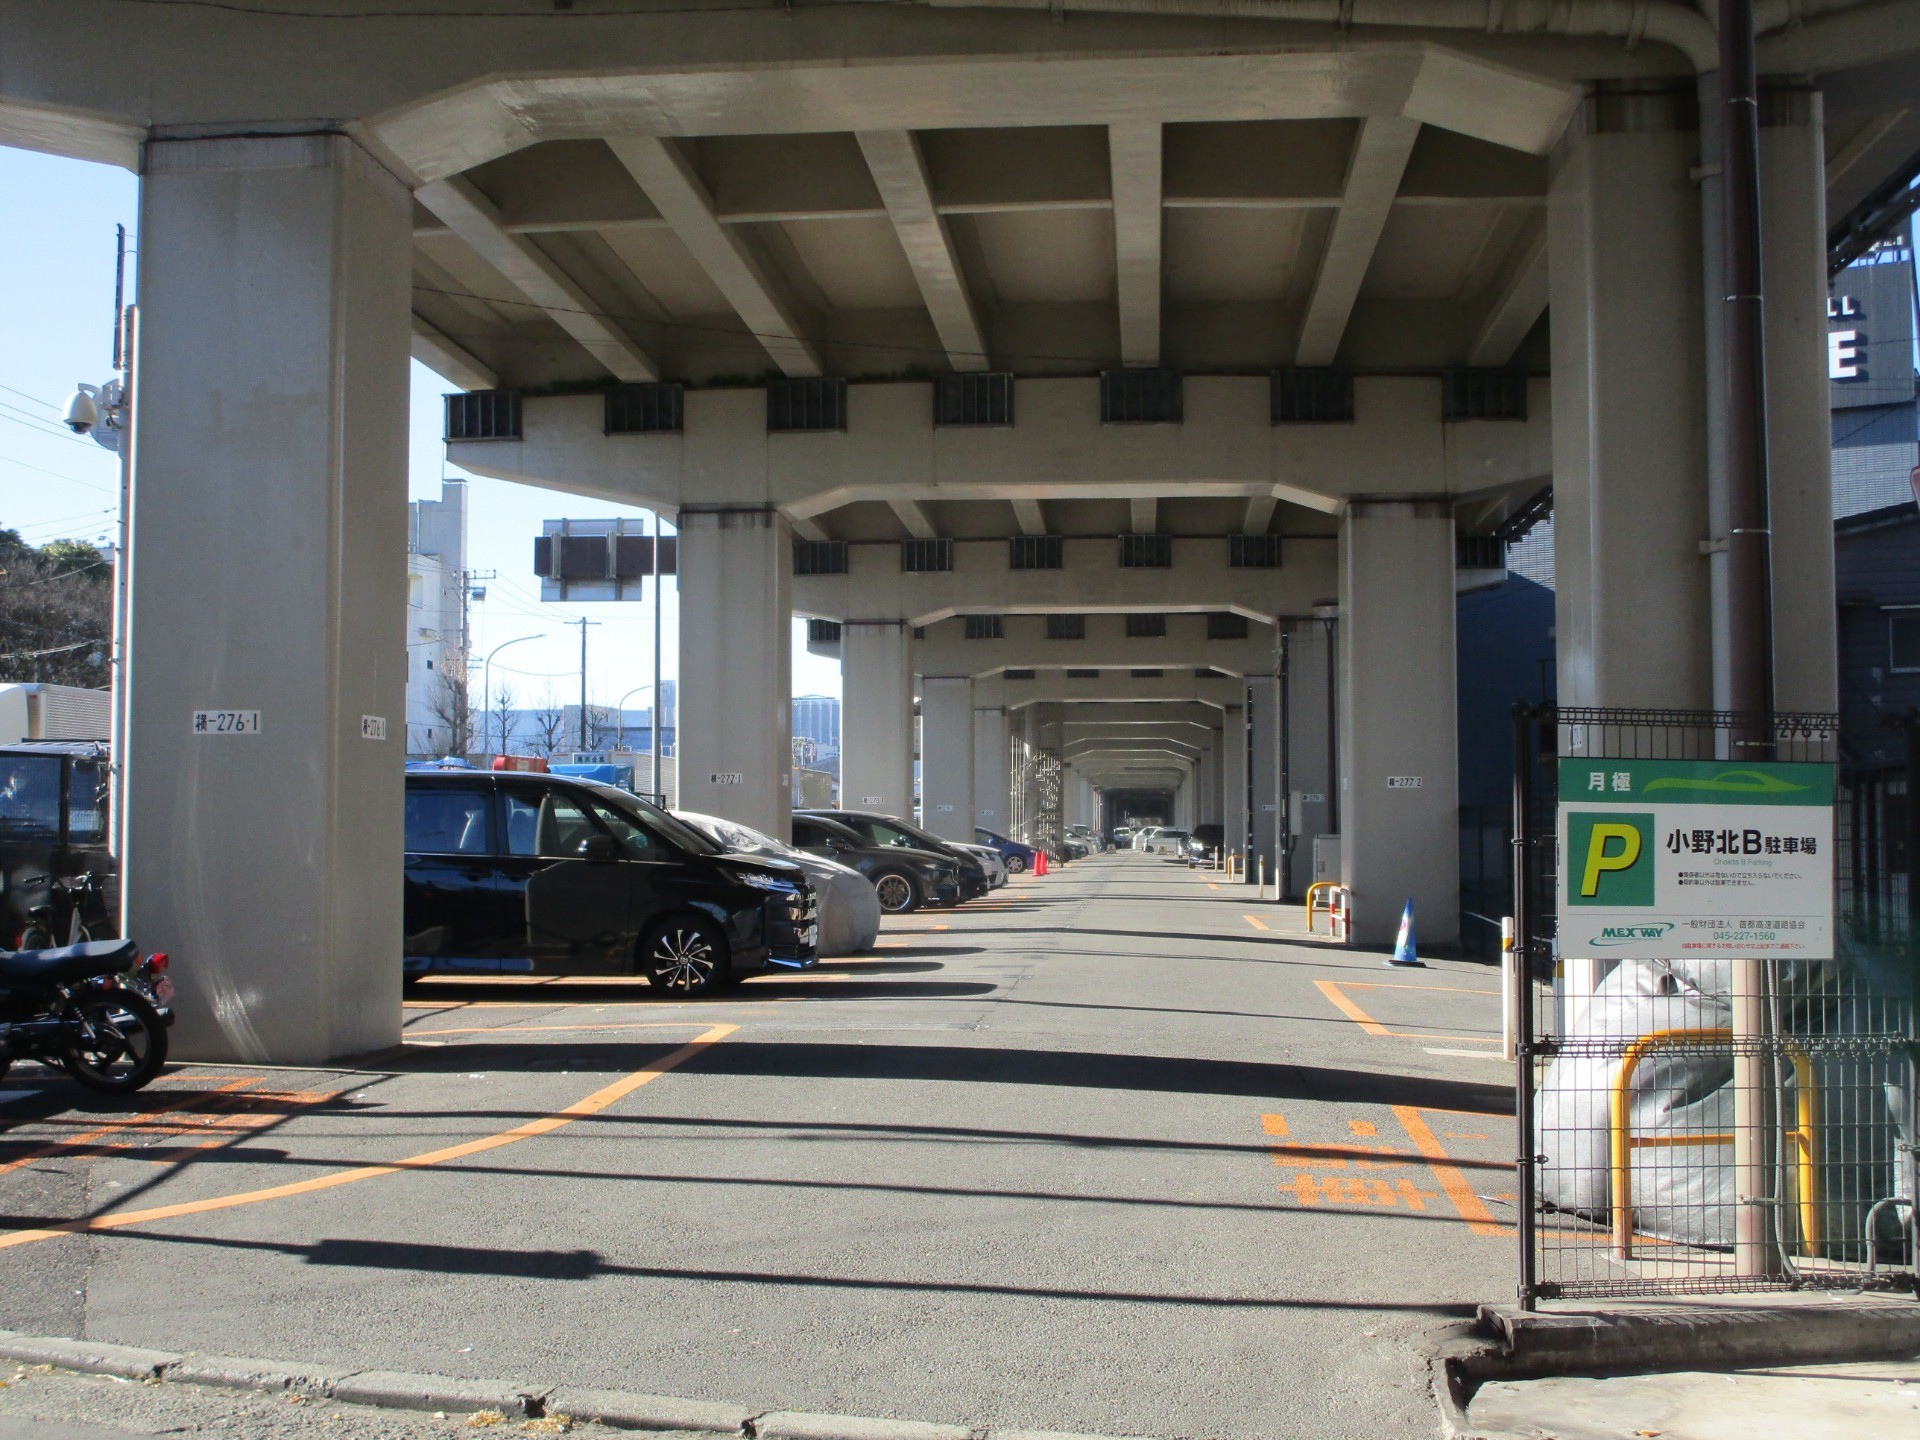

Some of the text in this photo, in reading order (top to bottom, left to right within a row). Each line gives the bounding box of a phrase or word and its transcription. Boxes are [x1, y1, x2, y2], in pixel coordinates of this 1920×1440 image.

[1588, 771, 1631, 792] 月極
[1666, 828, 1817, 855] 小野北B駐車場
[1580, 823, 1642, 897] P
[1681, 920, 1732, 929] 一般財団法人
[1713, 931, 1776, 940] 045-227-1560
